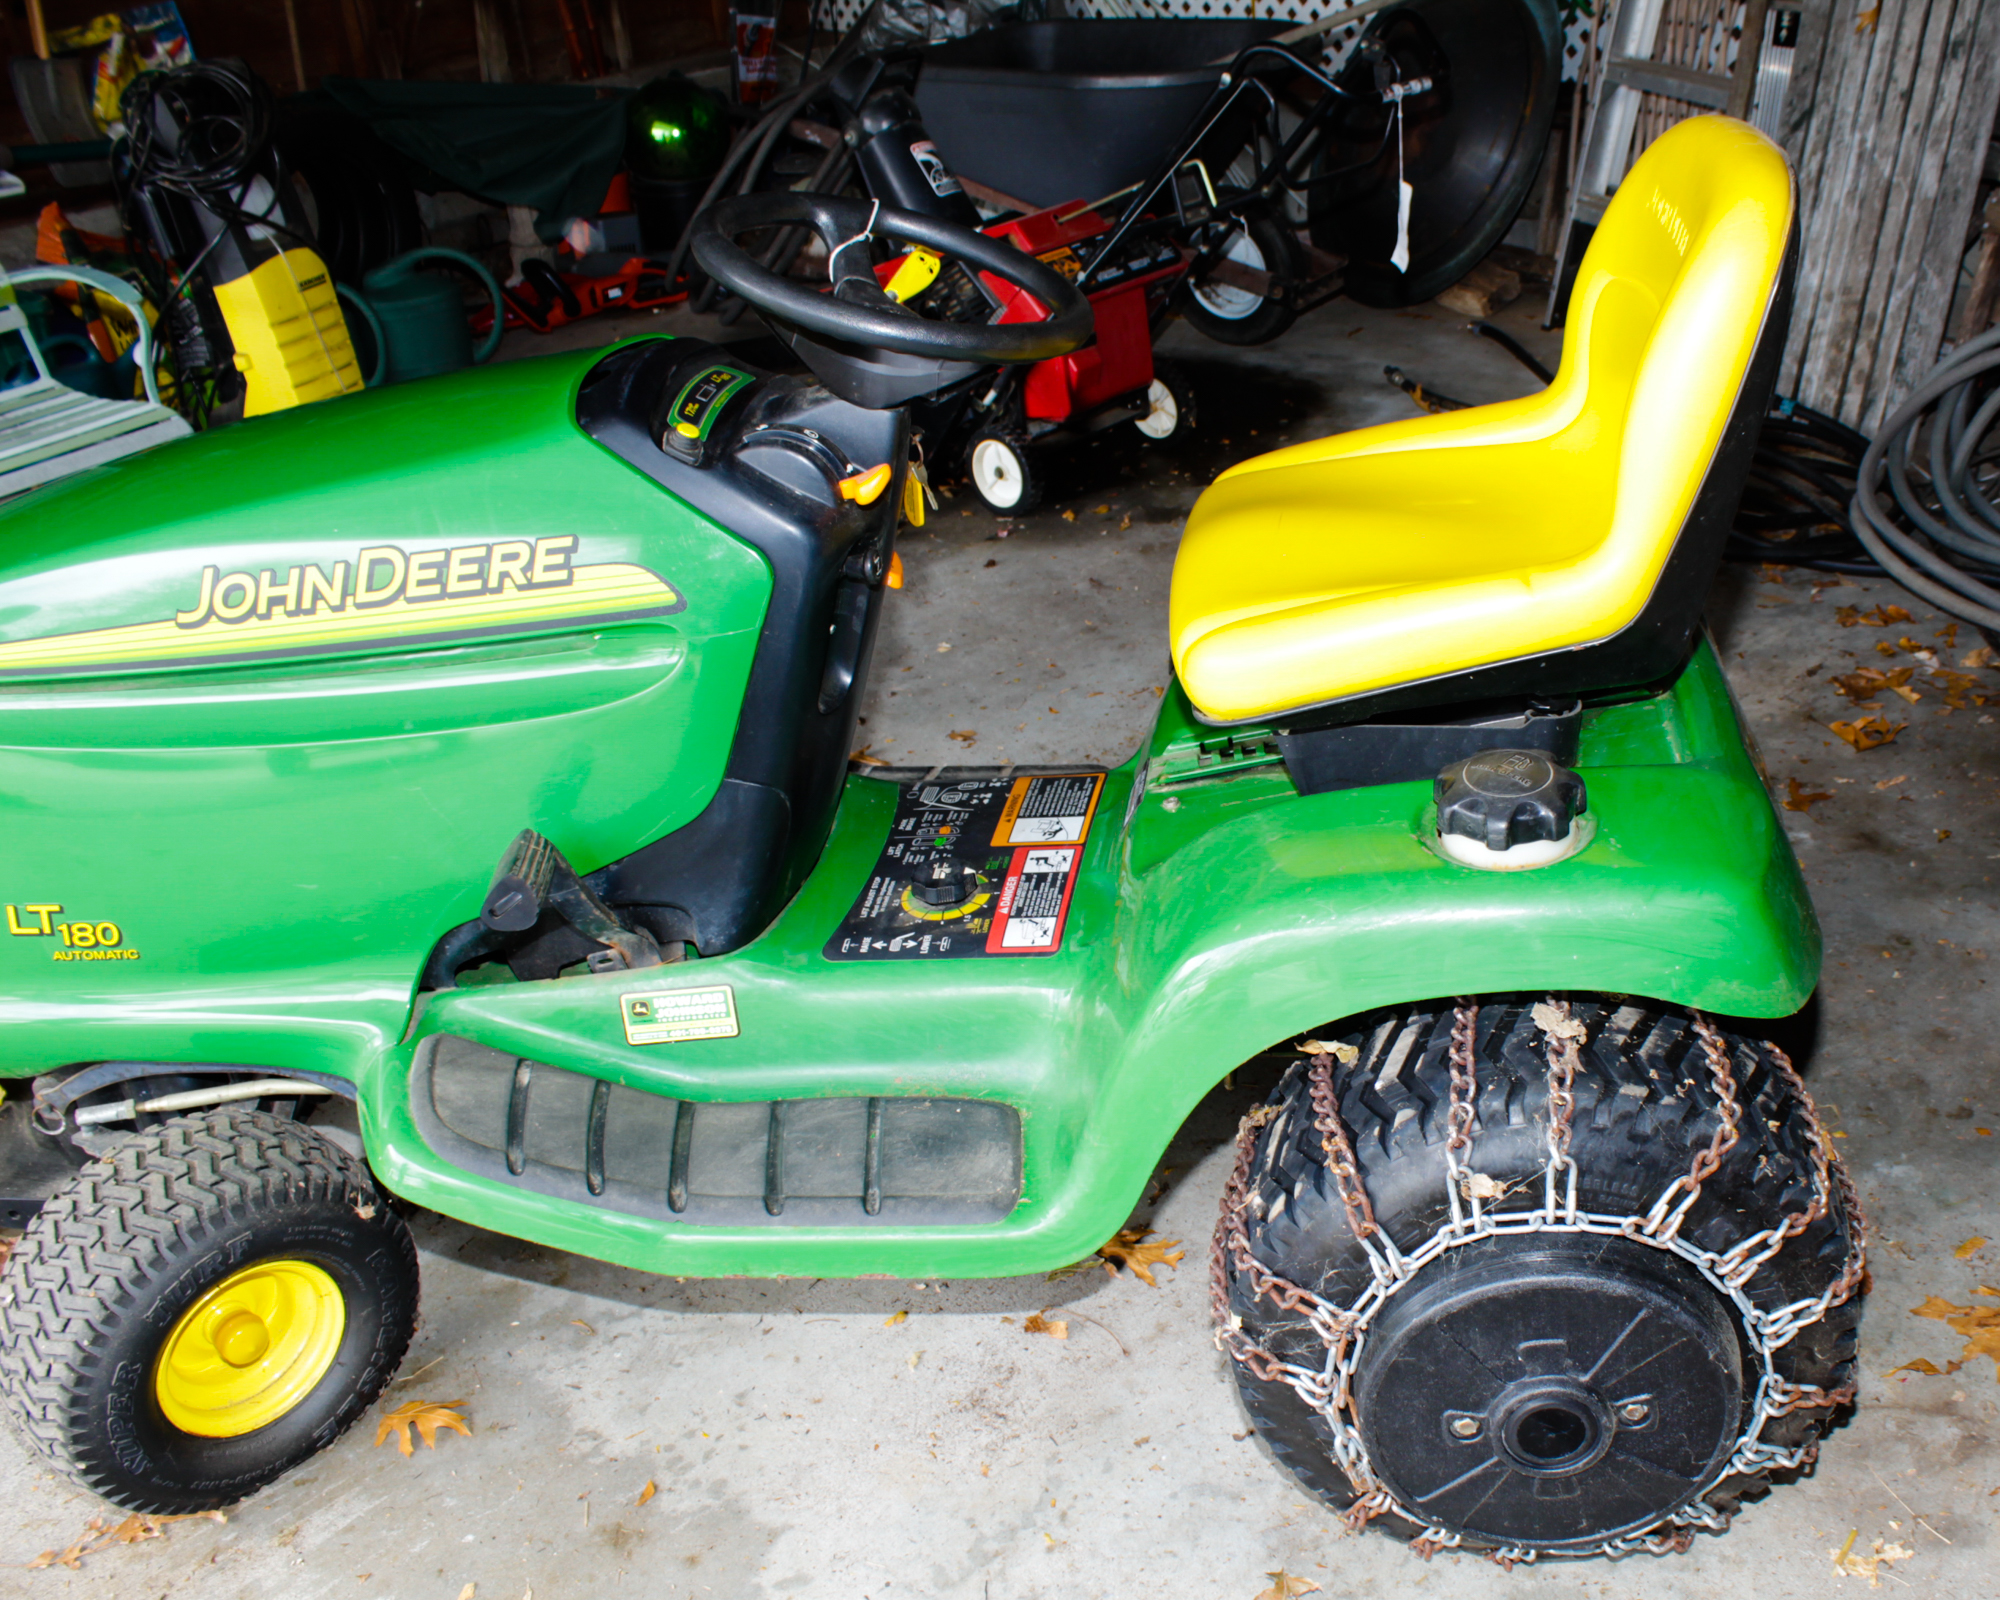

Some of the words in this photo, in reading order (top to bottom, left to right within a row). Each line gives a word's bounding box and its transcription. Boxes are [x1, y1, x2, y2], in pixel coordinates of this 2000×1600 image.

[174, 560, 351, 629] JOHN
[353, 534, 579, 608] DEERE
[1004, 794, 1021, 818] WARNING
[1001, 876, 1019, 908] DANGER
[6, 903, 64, 936] LT
[57, 921, 123, 948] 180
[53, 949, 140, 962] AUTOMATIC
[860, 936, 872, 953] RAISE
[920, 934, 932, 954] LOWER
[652, 992, 725, 1009] HOWARD
[143, 1230, 253, 1328] TURF
[107, 1361, 154, 1476] SUPER
